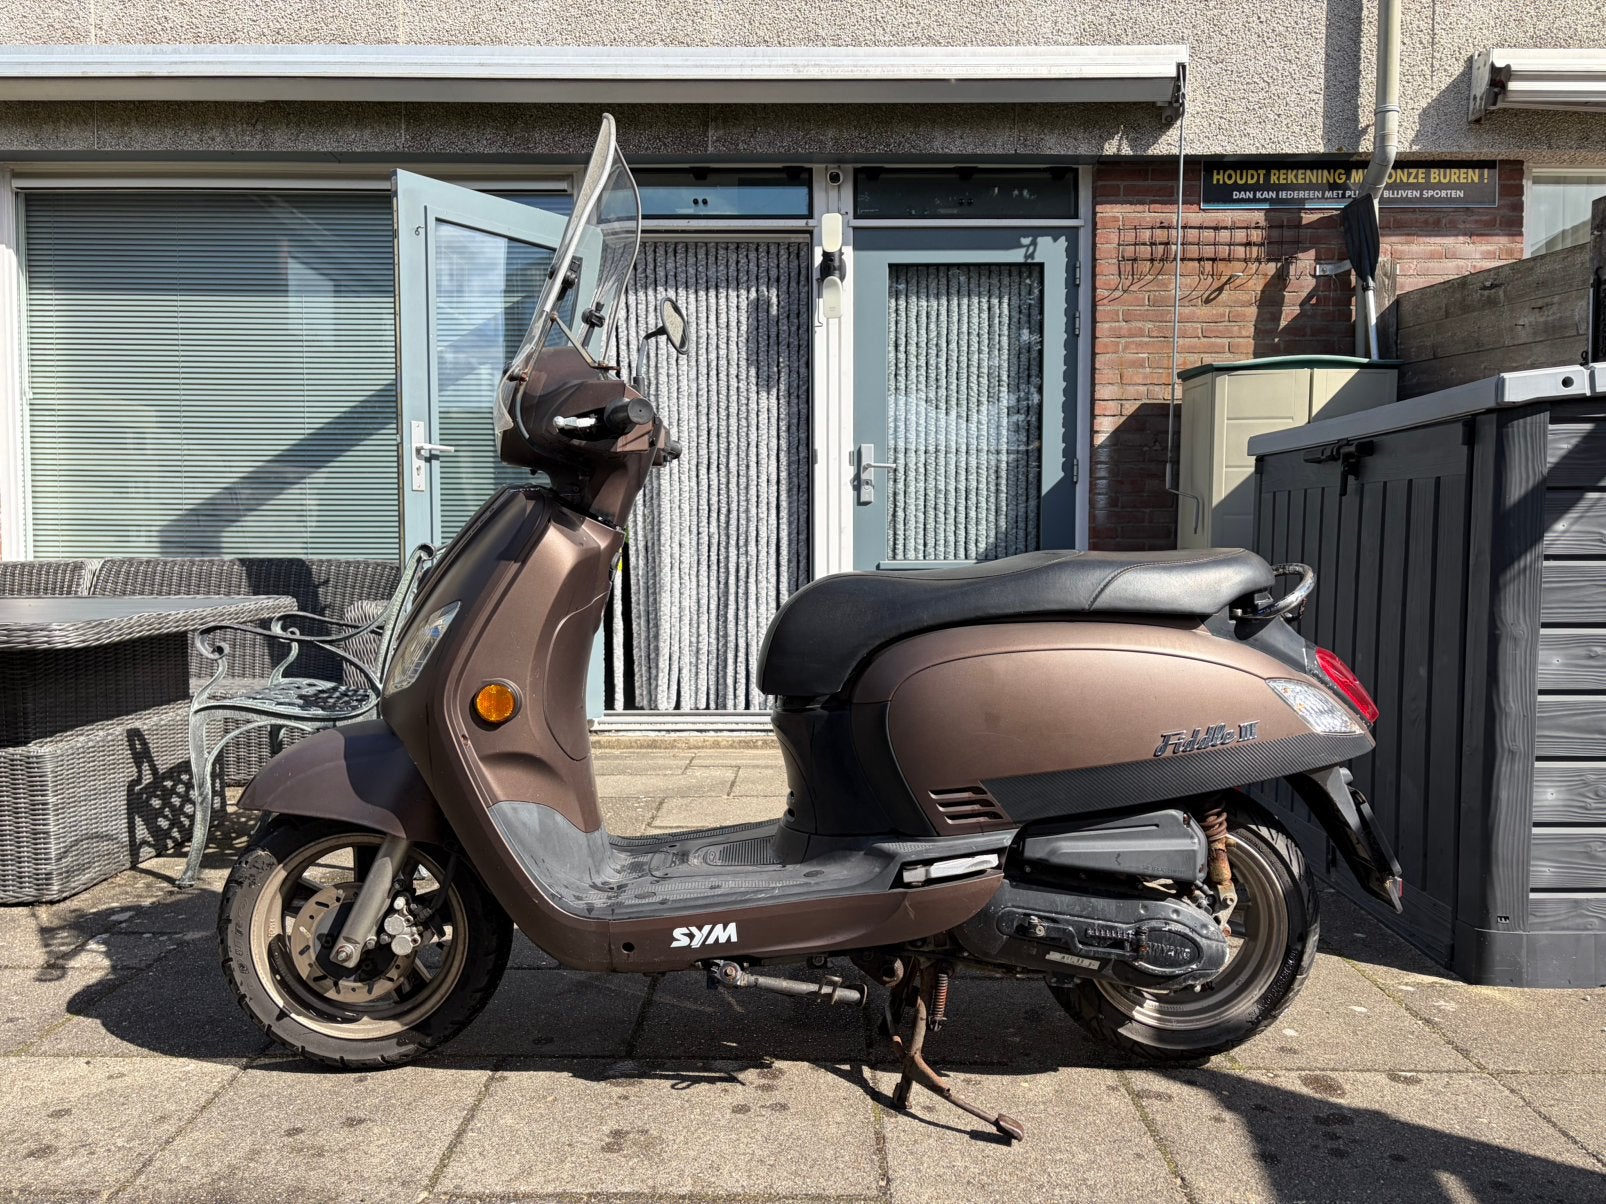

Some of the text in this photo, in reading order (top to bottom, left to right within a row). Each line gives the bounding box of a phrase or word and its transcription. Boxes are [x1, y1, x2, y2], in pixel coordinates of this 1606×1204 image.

[1212, 169, 1266, 185] HOUDT
[1270, 168, 1346, 184] REKENING
[1386, 168, 1426, 183] ONZE
[1430, 168, 1479, 183] BUREN
[1484, 168, 1489, 183] !
[1232, 190, 1254, 199] DAN
[1256, 190, 1276, 199] KAN
[1278, 190, 1322, 199] IEDEREEN
[1324, 190, 1343, 199] MET
[1383, 190, 1420, 198] BLIJVEN
[1422, 190, 1464, 198] SPORTEN
[1153, 722, 1236, 757] Fiddle
[670, 922, 737, 948] SYM
